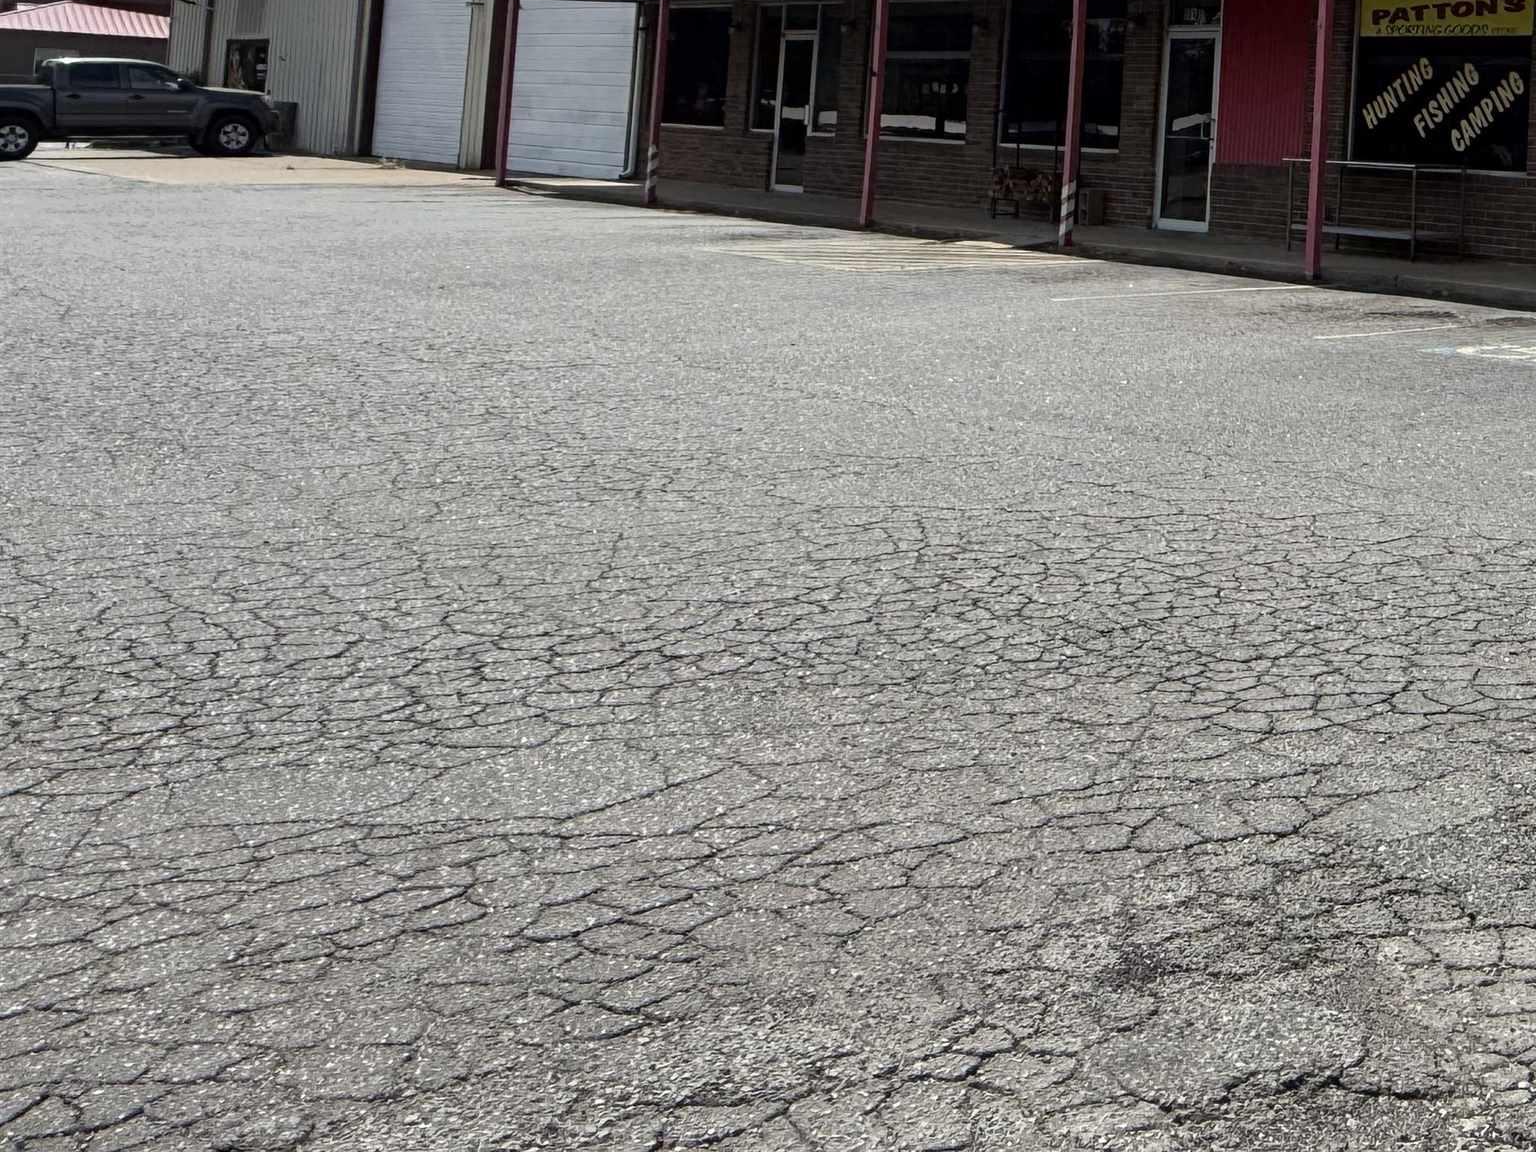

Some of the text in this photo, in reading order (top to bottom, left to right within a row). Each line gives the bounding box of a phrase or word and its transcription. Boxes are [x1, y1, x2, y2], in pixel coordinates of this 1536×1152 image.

[1385, 24, 1441, 34] SPORTING
[1445, 23, 1489, 34] GOODS
[1362, 57, 1434, 130] HUNTING
[1412, 62, 1480, 140] FISHING
[1450, 70, 1525, 153] CAMPING
